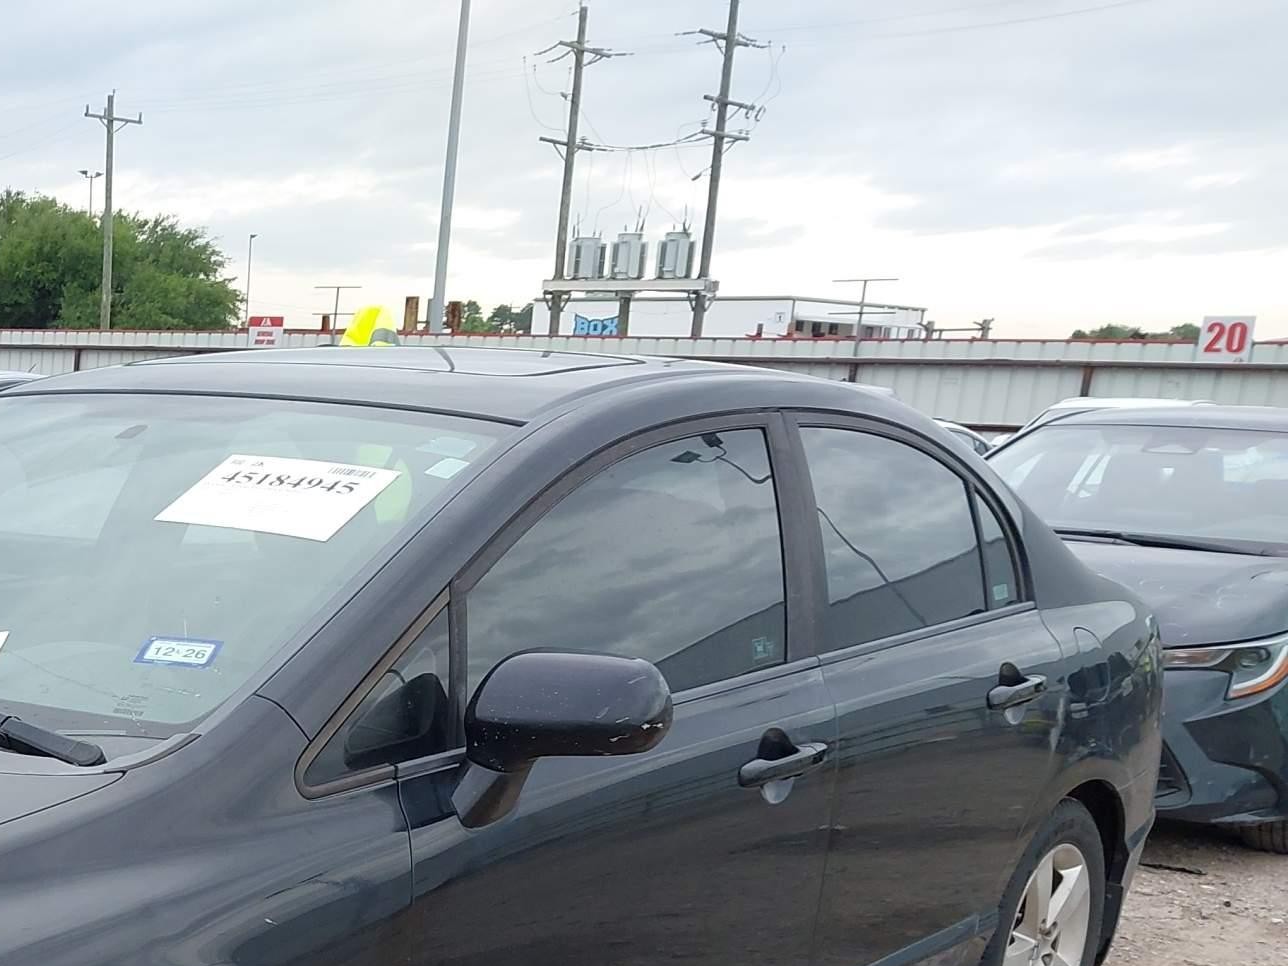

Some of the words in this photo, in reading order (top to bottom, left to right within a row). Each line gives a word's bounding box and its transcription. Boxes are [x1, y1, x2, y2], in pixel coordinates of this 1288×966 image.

[573, 313, 619, 336] BOX
[1204, 321, 1248, 353] 20
[221, 469, 360, 495] 45184945
